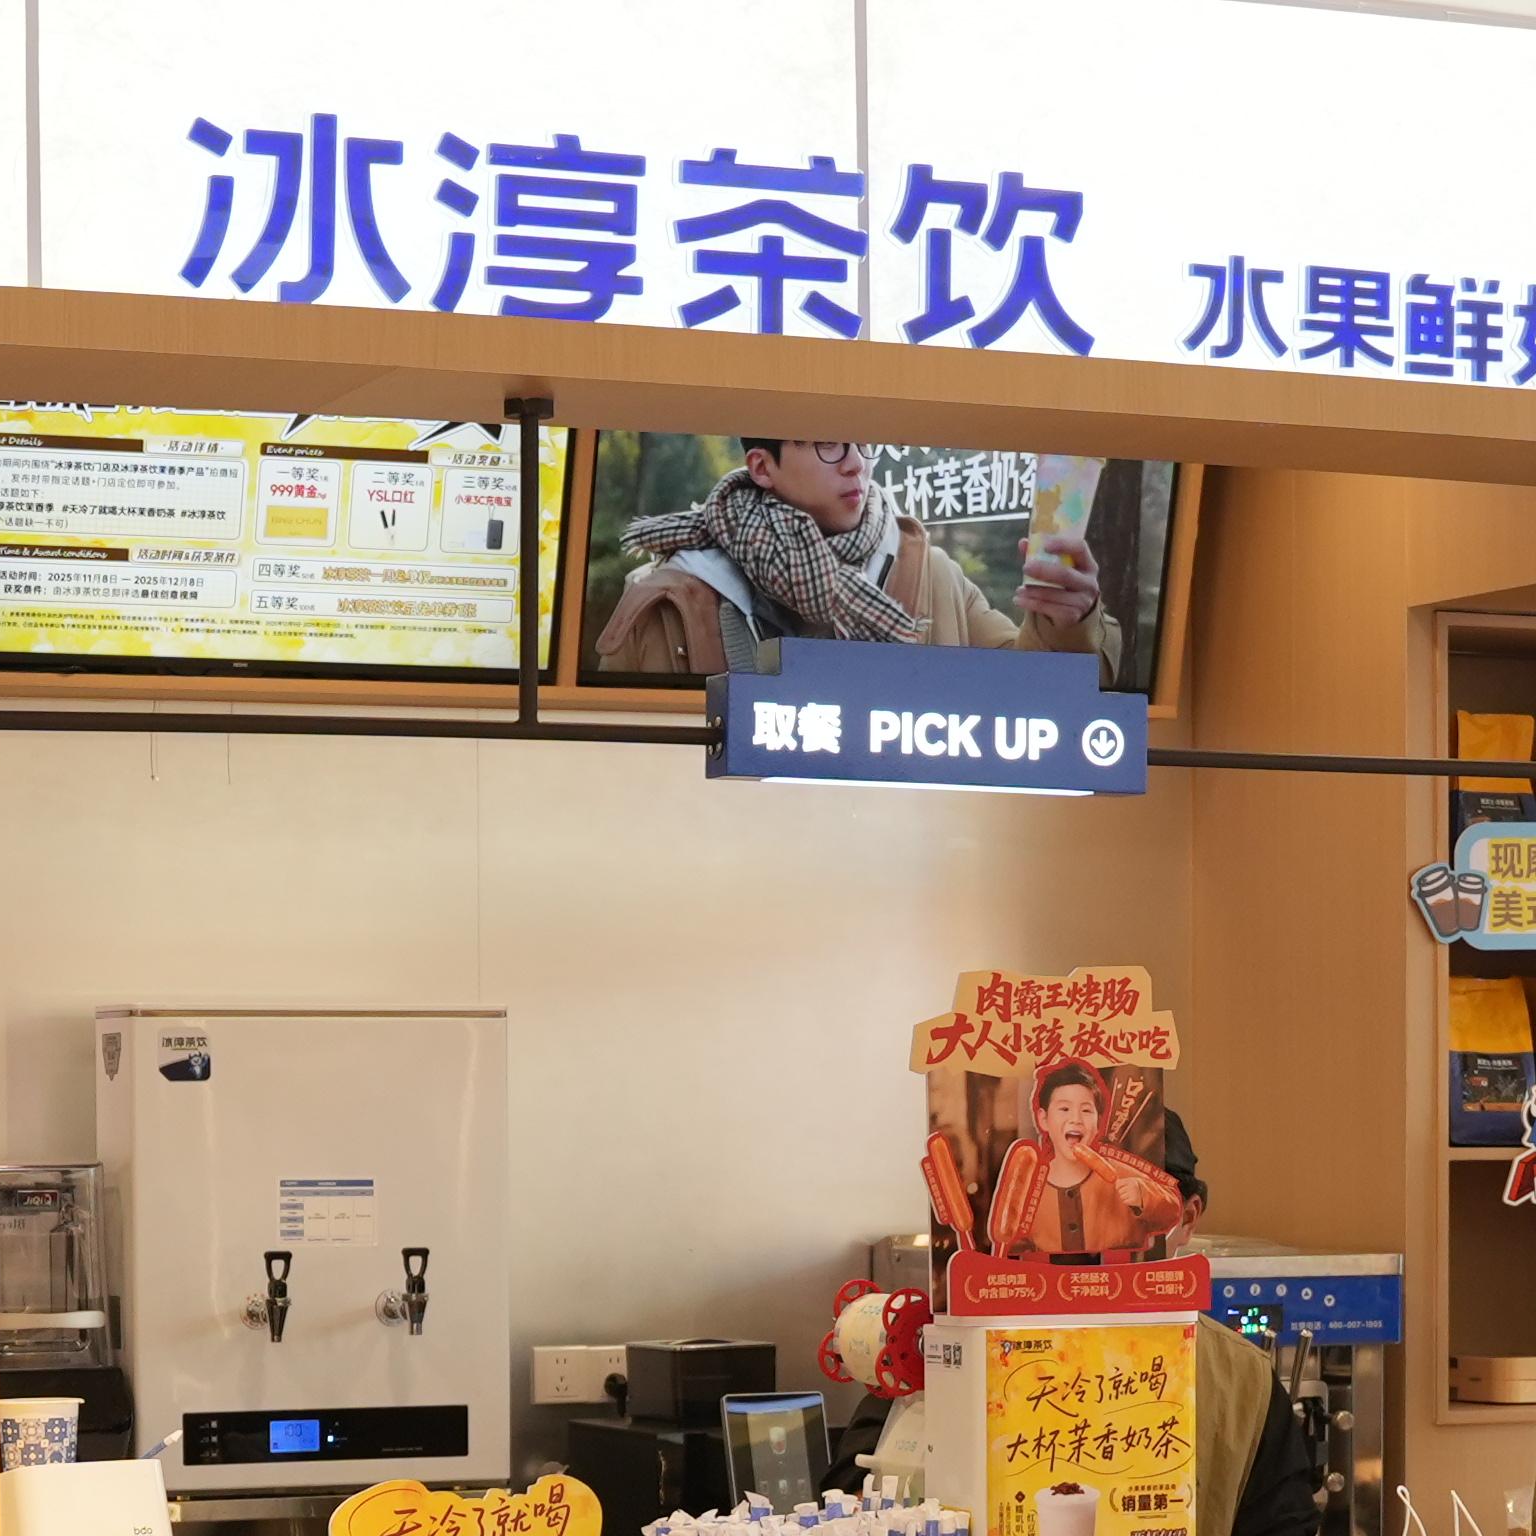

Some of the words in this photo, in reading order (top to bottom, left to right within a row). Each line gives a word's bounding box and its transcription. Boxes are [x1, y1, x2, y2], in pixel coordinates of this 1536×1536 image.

[181, 114, 1096, 361] 冰淳茶饮
[277, 467, 319, 481] 一等奖
[373, 471, 415, 486] 二等奖
[462, 476, 504, 490] 三等奖
[367, 489, 415, 504] YSL口红
[258, 563, 301, 578] 四等奖
[255, 595, 298, 610] 五等奖
[753, 702, 842, 754] 取餐
[870, 710, 982, 760] PICK
[995, 714, 1060, 761] UP
[977, 972, 1140, 1022] 肉霸王烤肠
[926, 1013, 1065, 1066] 大人小孩
[1070, 1021, 1172, 1065] 放心吃
[1025, 1355, 1168, 1417] 天冷了就喝
[1005, 1416, 1191, 1474] 大杯茉香奶茶
[1122, 1494, 1184, 1513] 销量第一
